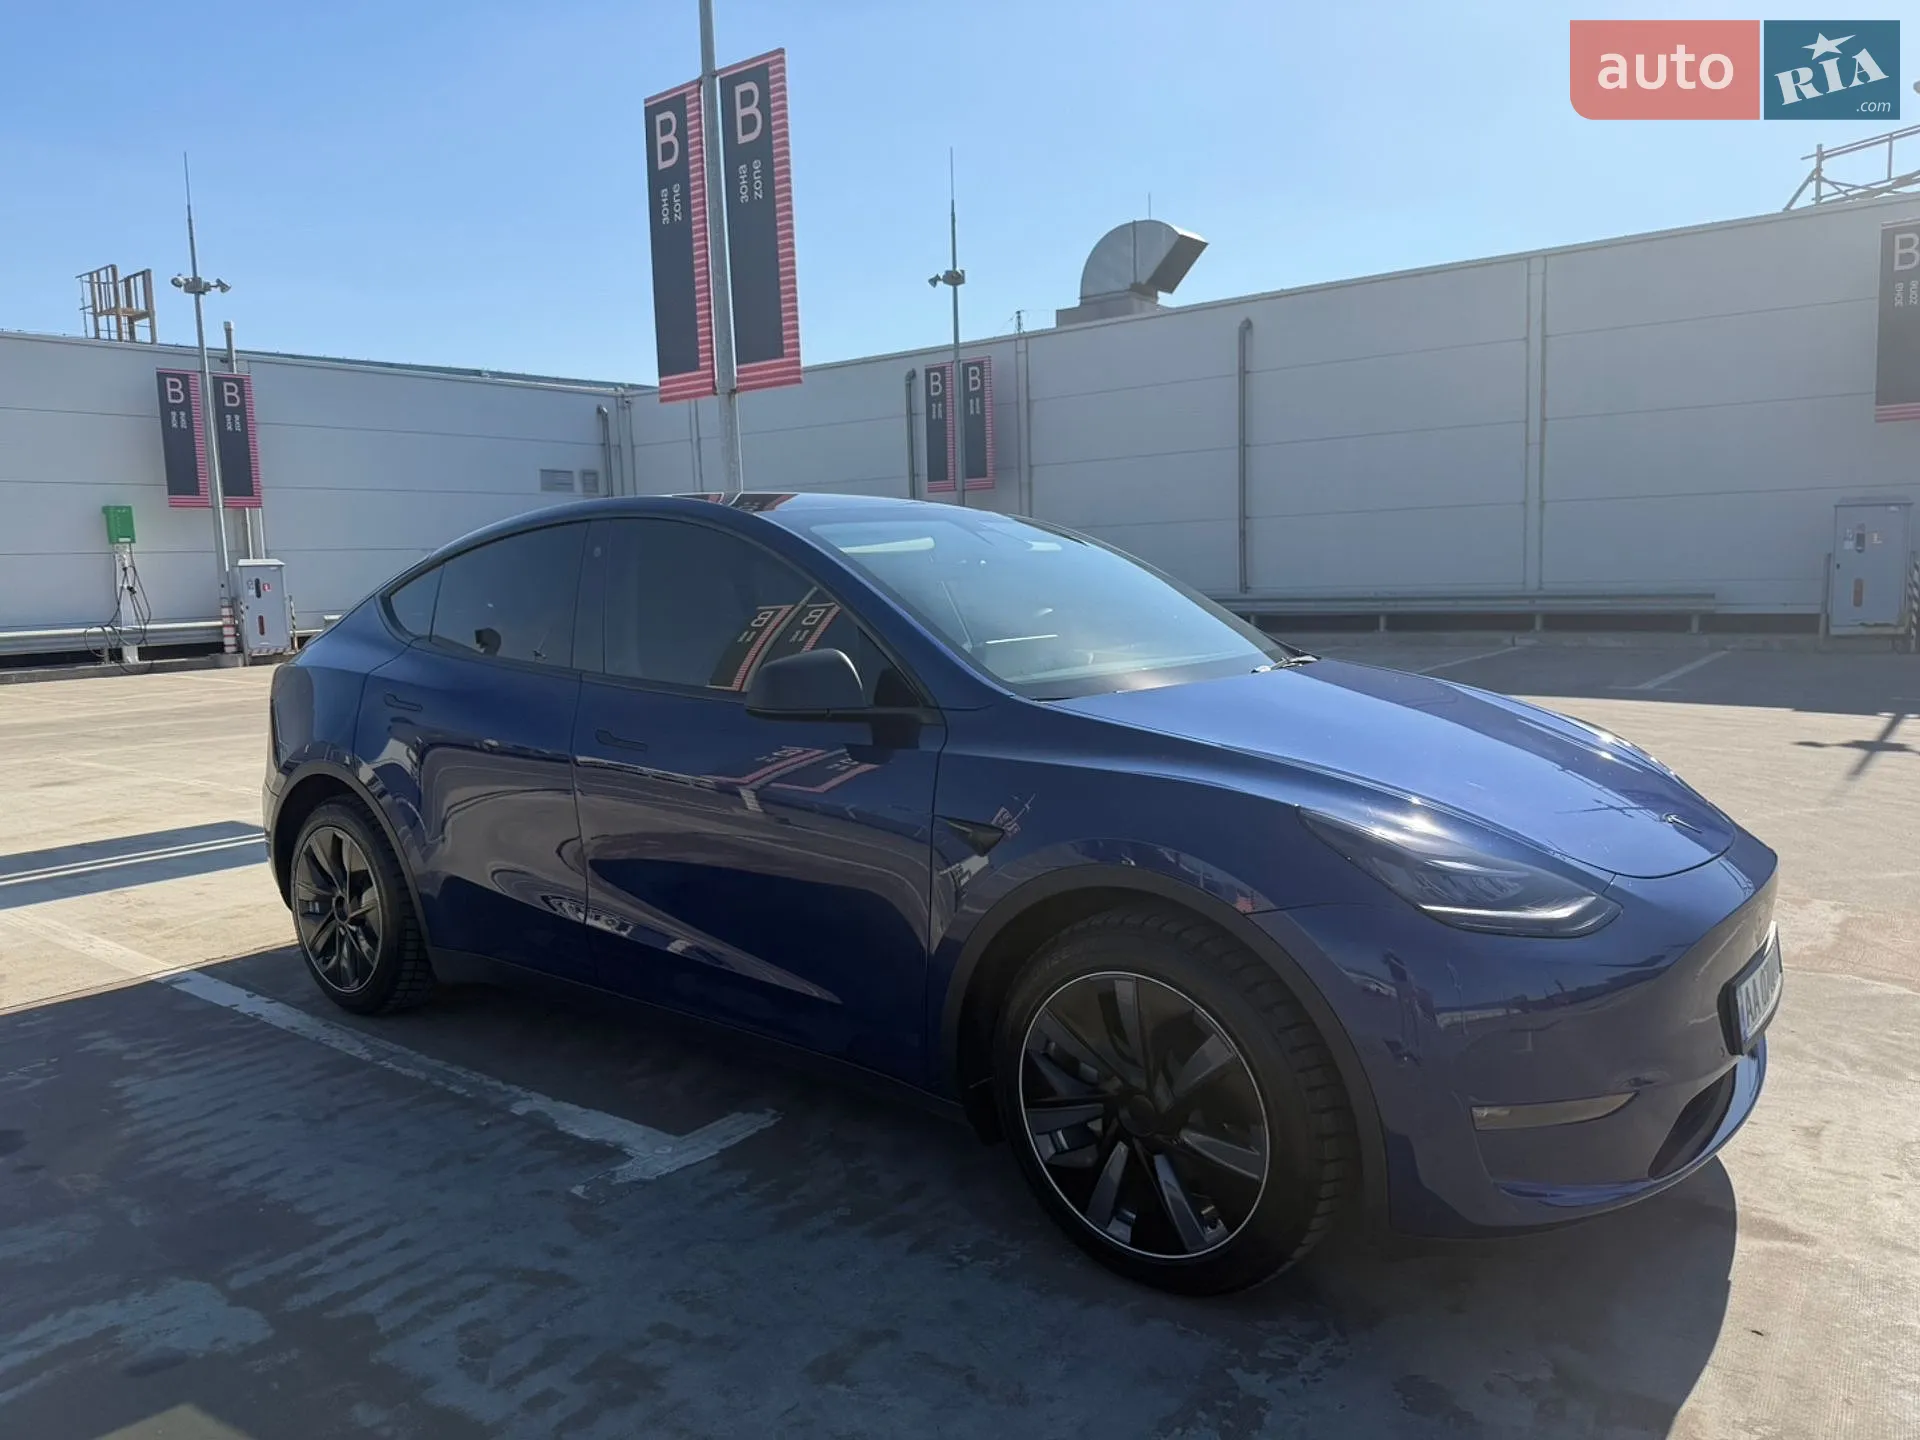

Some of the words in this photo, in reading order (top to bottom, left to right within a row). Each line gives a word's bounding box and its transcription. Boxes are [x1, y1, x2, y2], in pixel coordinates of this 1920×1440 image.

[734, 80, 763, 145] B
[655, 110, 680, 171] B
[738, 164, 749, 204] зона
[752, 159, 763, 200] zone
[661, 188, 670, 225] зона
[672, 183, 683, 222] zone
[1894, 233, 1919, 272] B
[166, 377, 185, 404] B
[223, 381, 241, 407] B
[930, 371, 943, 397] B
[968, 366, 981, 392] B
